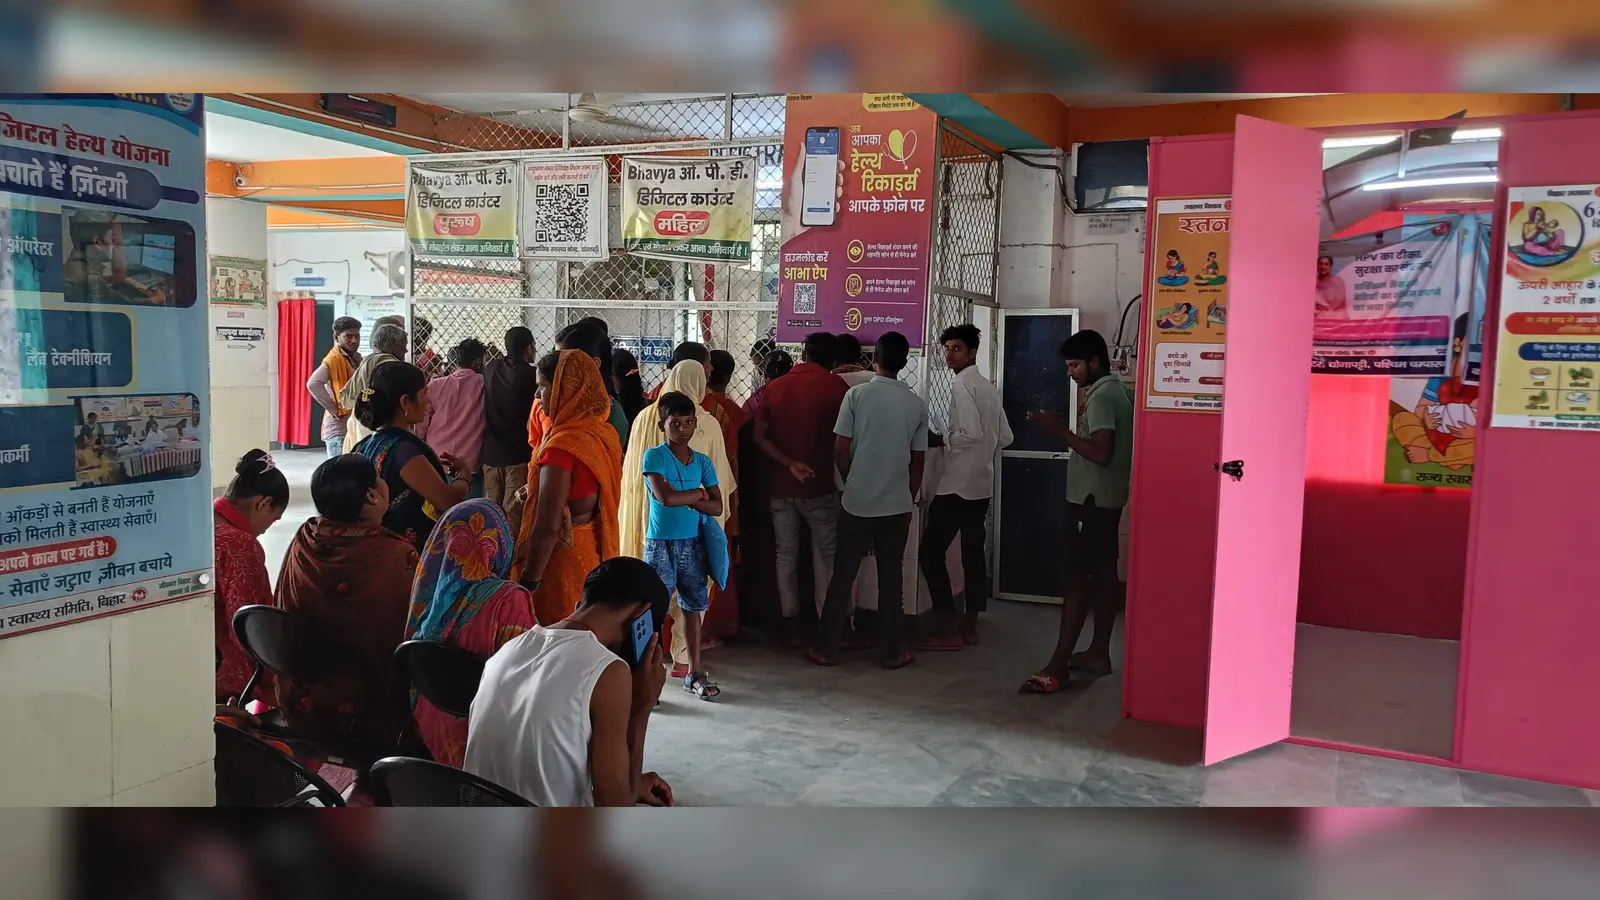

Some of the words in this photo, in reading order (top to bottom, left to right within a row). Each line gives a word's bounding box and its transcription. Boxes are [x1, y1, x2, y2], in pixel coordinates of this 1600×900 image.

[63, 124, 106, 156] हेल्थ
[111, 135, 171, 166] योजना
[851, 134, 882, 146] आपका
[851, 148, 883, 172] हेल्थ
[49, 160, 67, 191] हैं
[70, 165, 128, 200] ज़िंदगी
[476, 169, 492, 185] पी.
[495, 168, 512, 185] डी.
[628, 166, 675, 184] Bhavya
[705, 162, 725, 180] पी.
[729, 161, 748, 180] डी.
[418, 192, 463, 209] डिजिटल
[465, 192, 501, 208] काउंटर
[636, 187, 688, 206] डिजिटल
[691, 188, 735, 206] काउंटर
[849, 196, 881, 213] आपके
[910, 199, 925, 212] पर
[658, 213, 708, 232] महिला
[7, 235, 53, 256] ऑपरेटर
[465, 244, 479, 253] आना
[480, 242, 503, 253] अनिवार्य
[690, 244, 706, 253] आना
[784, 251, 815, 262] डाउनलोड
[816, 251, 829, 262] करें
[1380, 252, 1395, 260] का
[784, 267, 810, 280] आभा
[812, 264, 828, 280] ऐप
[1355, 266, 1382, 277] सुरक्षा
[1542, 296, 1550, 304] 2
[50, 348, 112, 366] टेक्नीशियन
[6, 503, 50, 524] आँकड़ों
[53, 502, 64, 517] से
[68, 497, 98, 514] बनती
[102, 495, 111, 512] हैं
[112, 490, 155, 509] योजनाएँ
[25, 522, 65, 541] मिलती
[69, 519, 78, 537] हैं
[80, 518, 120, 533] स्वास्थ्य
[0, 551, 29, 572] अपने
[32, 552, 58, 566] काम
[61, 547, 76, 561] पर
[78, 541, 96, 559] गर्व
[9, 573, 50, 597] सेवाएँ
[139, 553, 173, 575] बचाये
[8, 608, 51, 629] स्वास्थ्य
[54, 600, 94, 618] समिति,
[98, 593, 126, 608] बिहार
